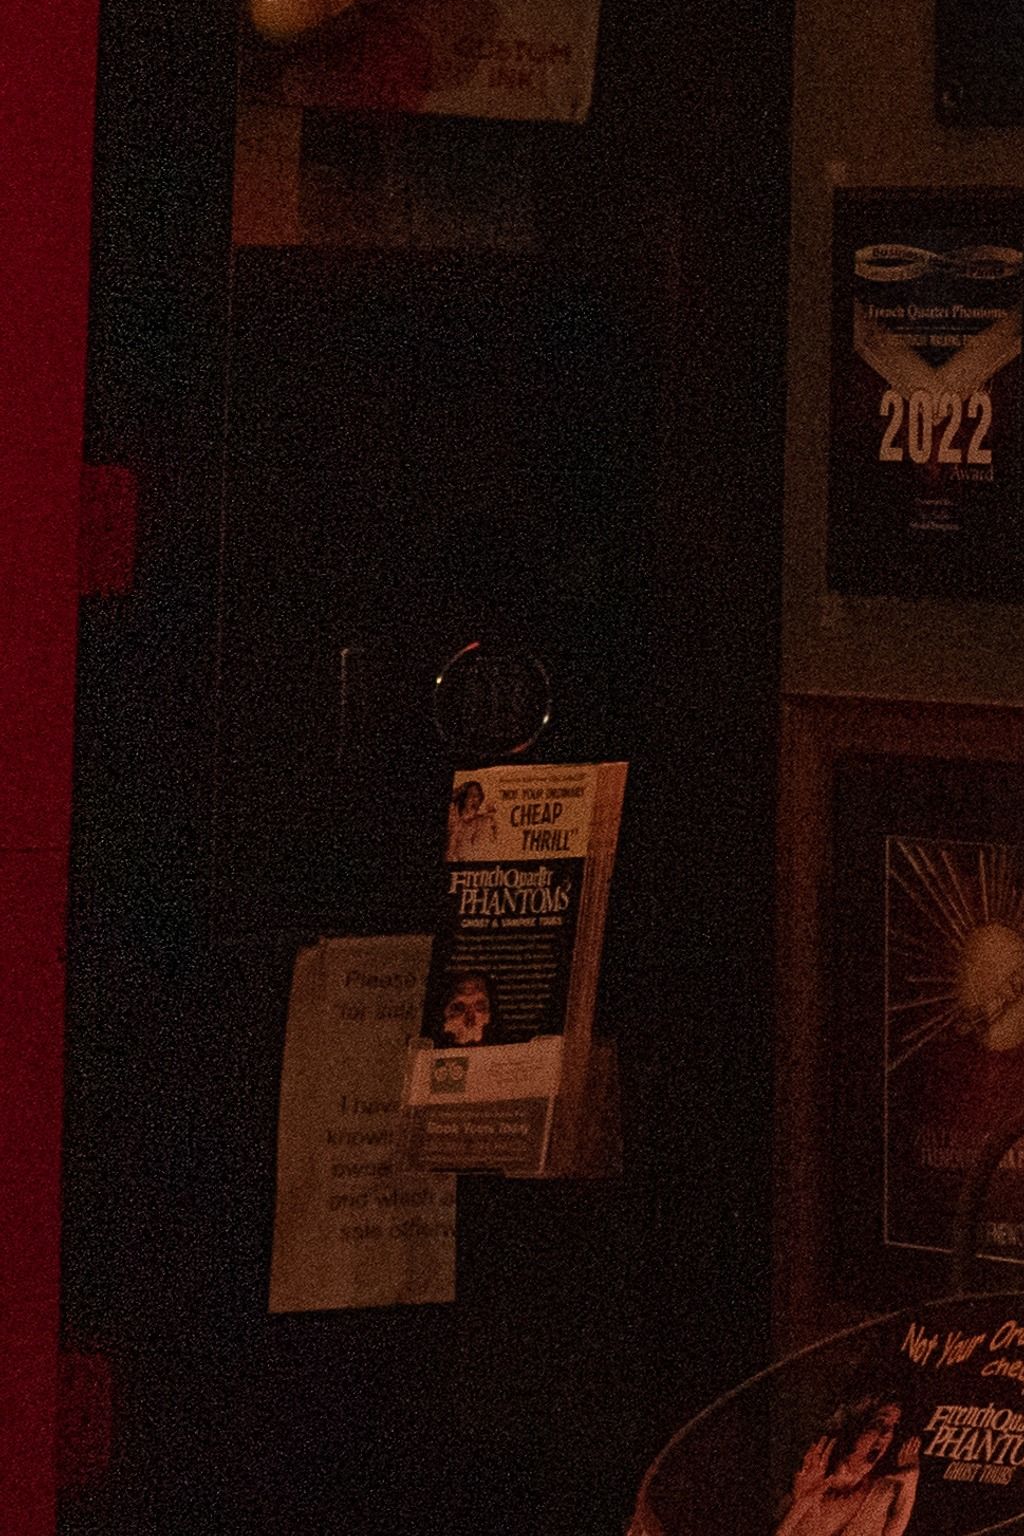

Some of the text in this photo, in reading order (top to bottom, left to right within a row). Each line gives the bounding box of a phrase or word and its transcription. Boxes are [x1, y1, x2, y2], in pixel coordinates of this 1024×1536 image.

[878, 388, 994, 464] 2022
[510, 802, 563, 827] CHEAP
[459, 881, 570, 915] PHANTOMS
[901, 1321, 939, 1367] Not
[936, 1330, 987, 1369] Your
